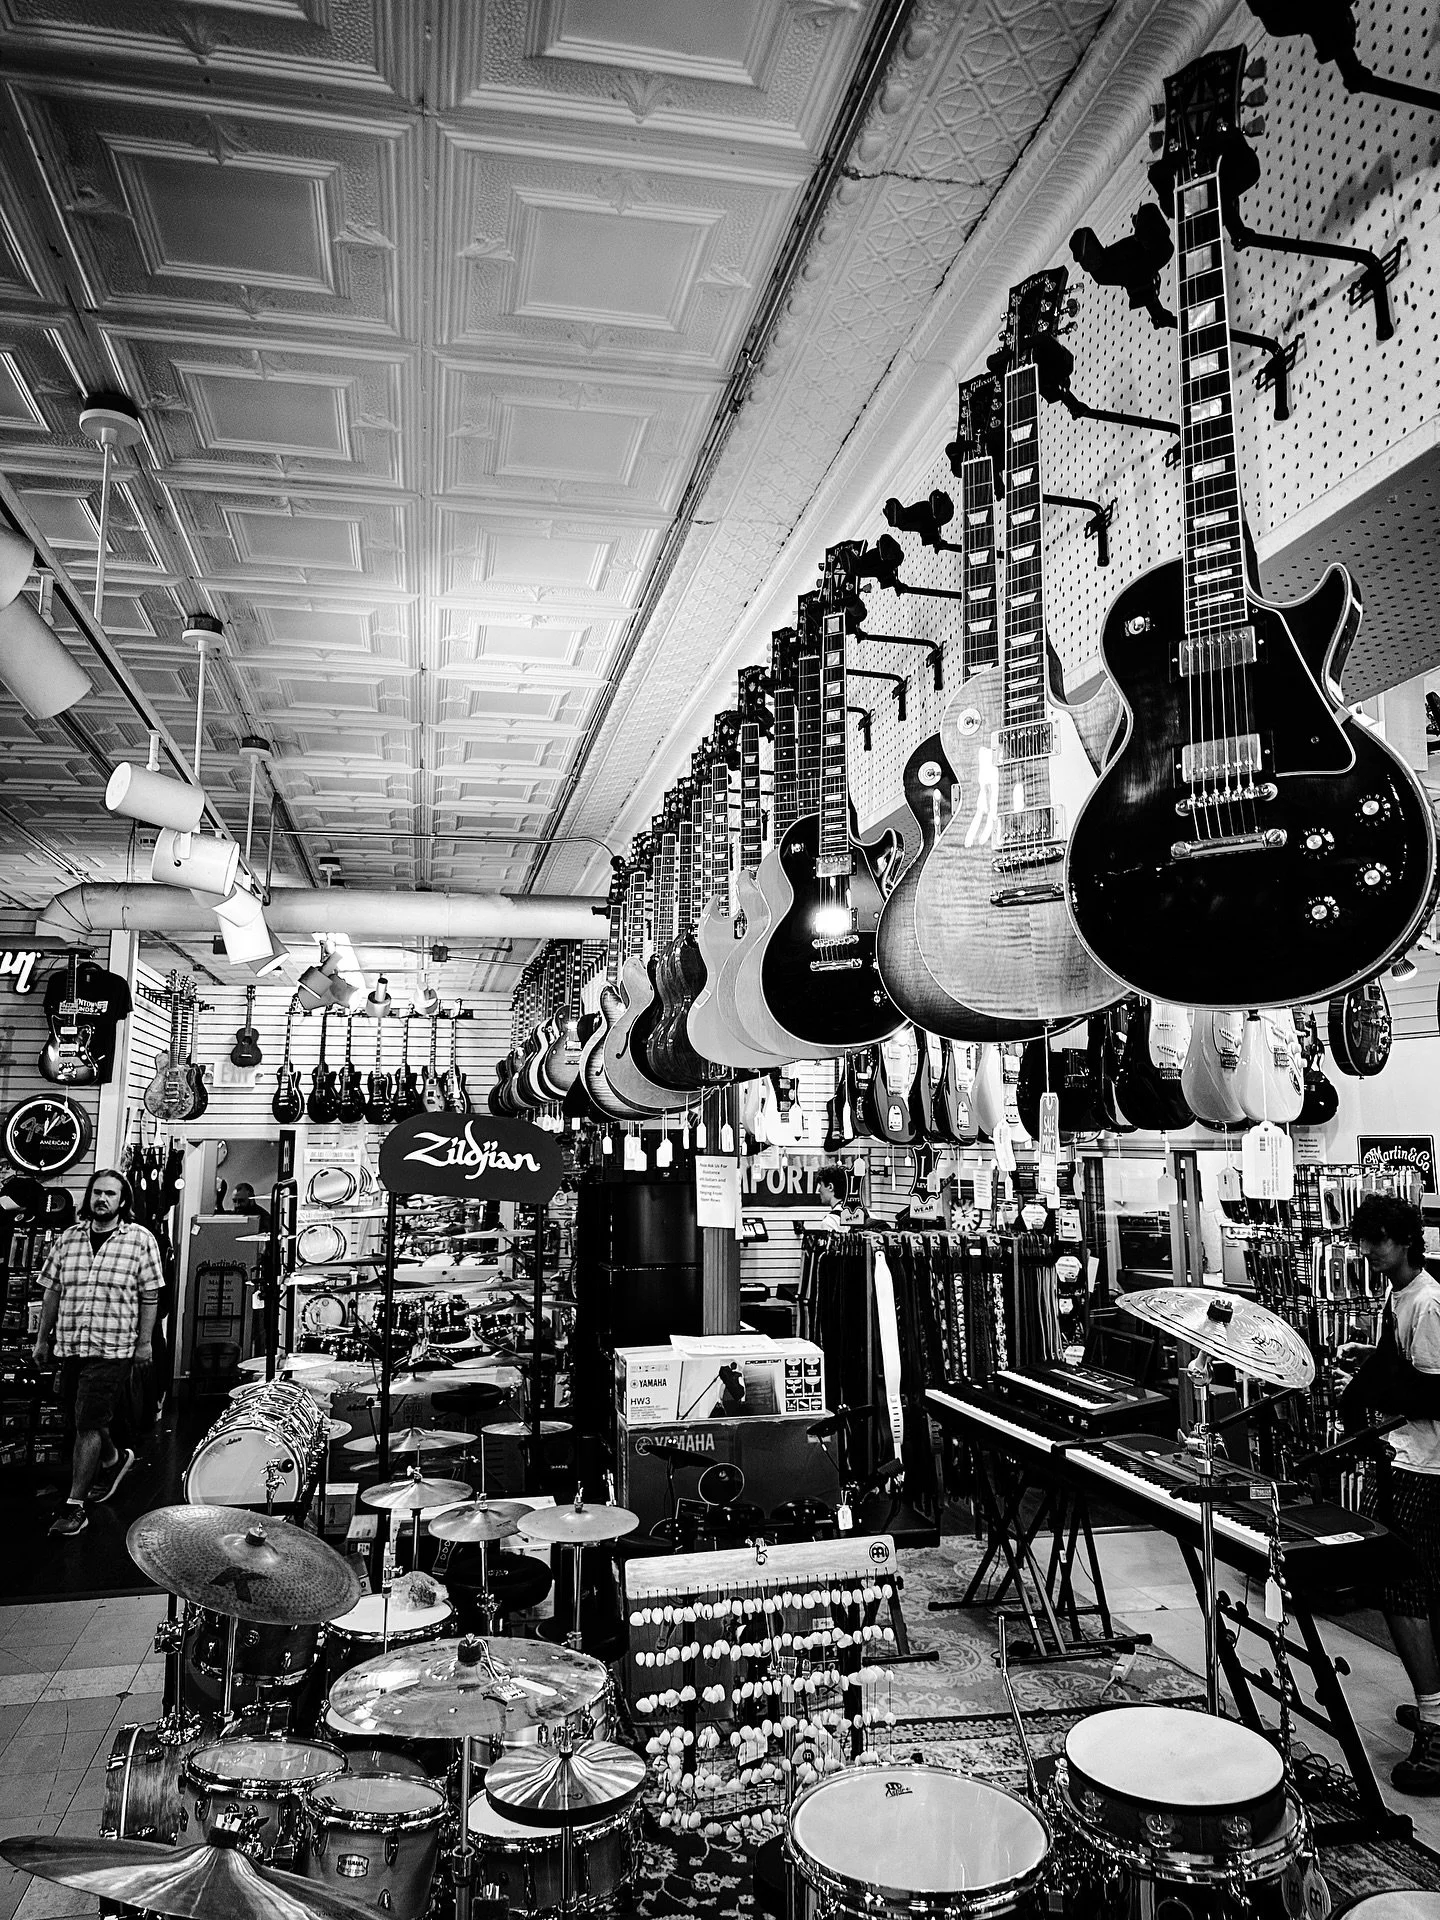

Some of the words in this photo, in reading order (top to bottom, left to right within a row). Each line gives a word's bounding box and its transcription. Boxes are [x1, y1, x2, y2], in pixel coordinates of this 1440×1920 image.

[44, 1104, 52, 1112] 12
[403, 1119, 541, 1180] Zildjian
[913, 1205, 934, 1213] WEAR
[639, 1378, 667, 1388] YAMAHA
[630, 1396, 651, 1406] HW3
